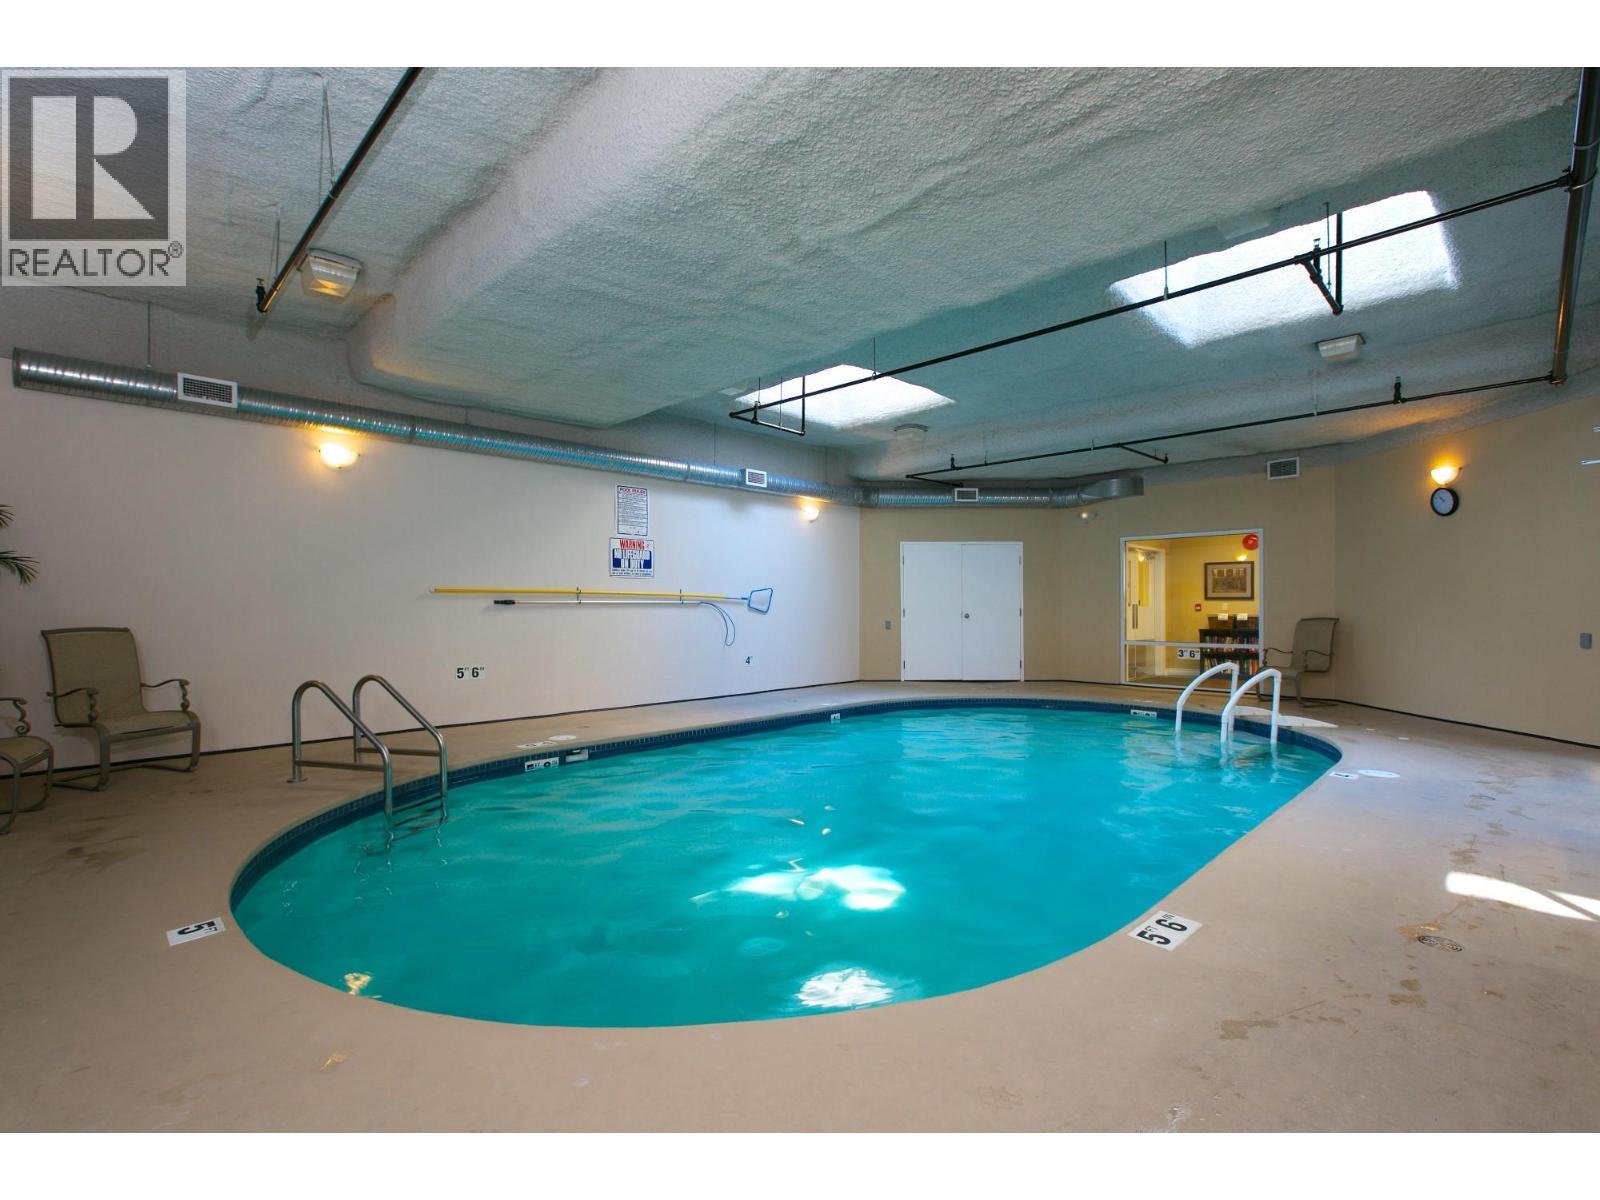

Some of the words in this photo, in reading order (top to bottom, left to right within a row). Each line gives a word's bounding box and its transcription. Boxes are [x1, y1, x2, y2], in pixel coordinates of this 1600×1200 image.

[620, 539, 645, 550] WARNING
[456, 667, 465, 679] 5
[471, 666, 480, 678] 6
